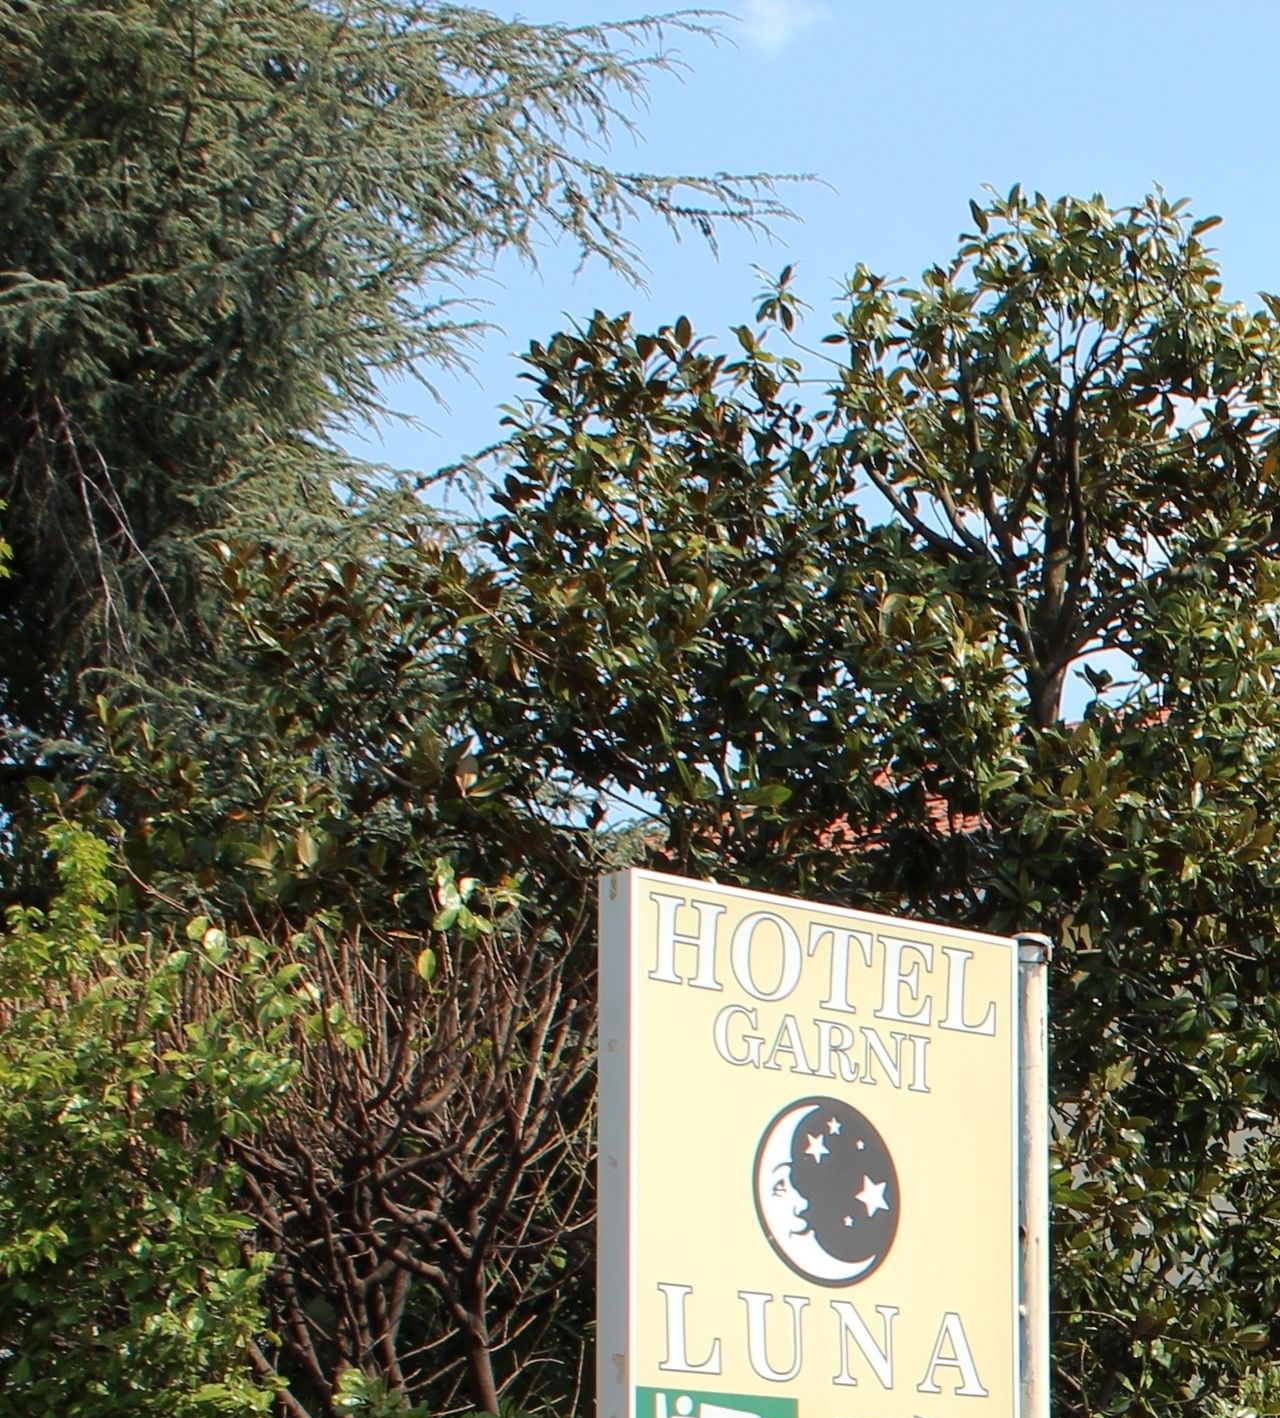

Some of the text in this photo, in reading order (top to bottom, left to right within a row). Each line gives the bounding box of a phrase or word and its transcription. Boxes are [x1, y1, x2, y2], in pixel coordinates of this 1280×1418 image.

[648, 891, 997, 1036] HOTEL
[713, 1004, 931, 1093] GARNI
[657, 1282, 989, 1397] LUNA
